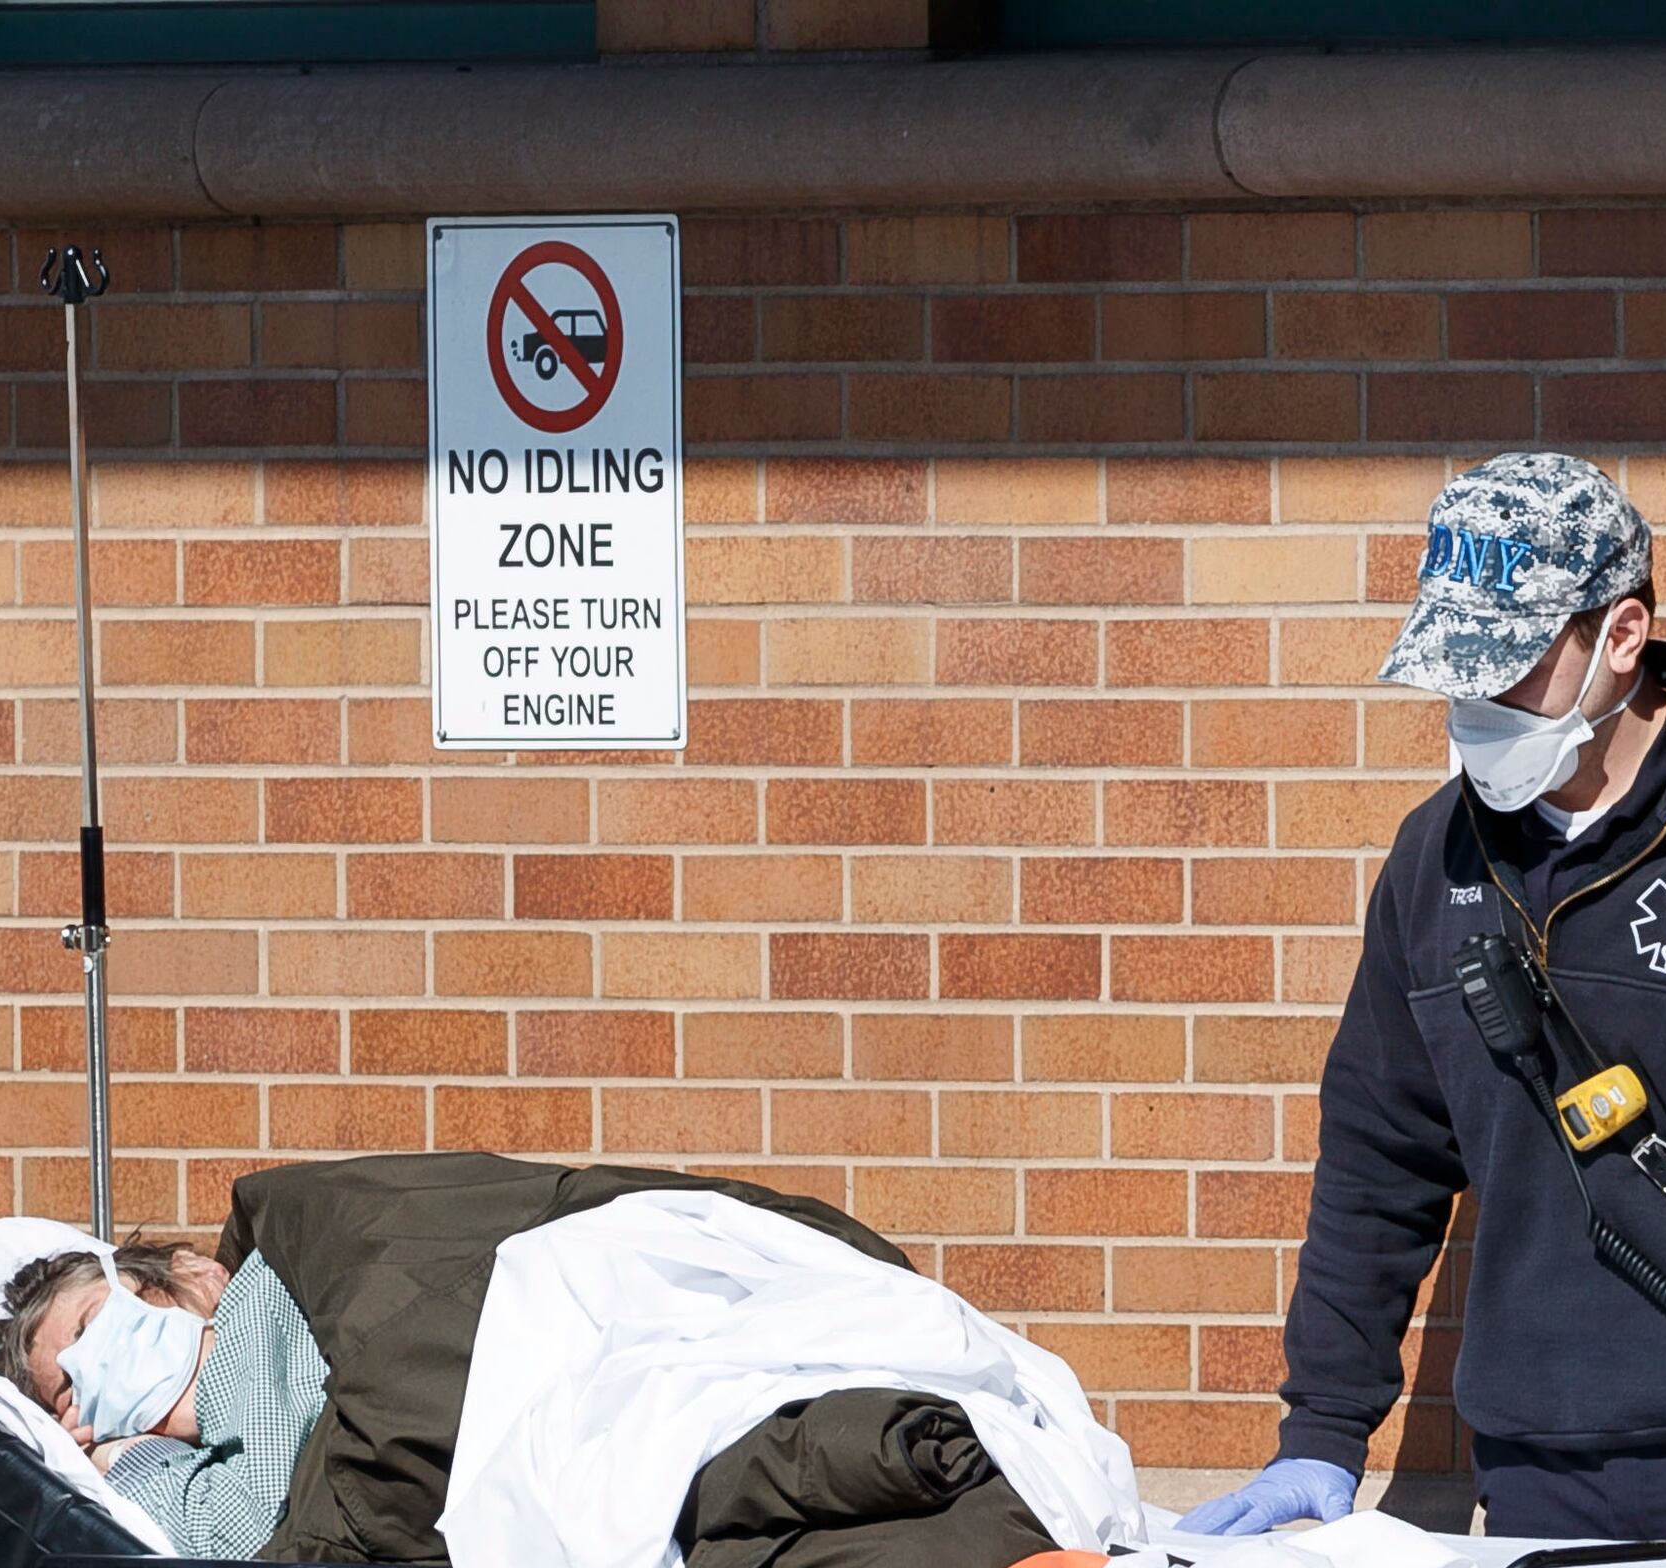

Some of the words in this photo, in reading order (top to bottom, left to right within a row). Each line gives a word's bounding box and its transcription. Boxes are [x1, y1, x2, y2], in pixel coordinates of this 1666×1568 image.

[448, 449, 509, 494] NO
[525, 447, 664, 494] IDLING
[498, 523, 614, 567] ZONE
[454, 599, 570, 630] PLEASE
[581, 598, 662, 630] TURN
[483, 646, 539, 678] OFF
[552, 646, 635, 678] YOUR
[503, 694, 616, 726] ENGINE
